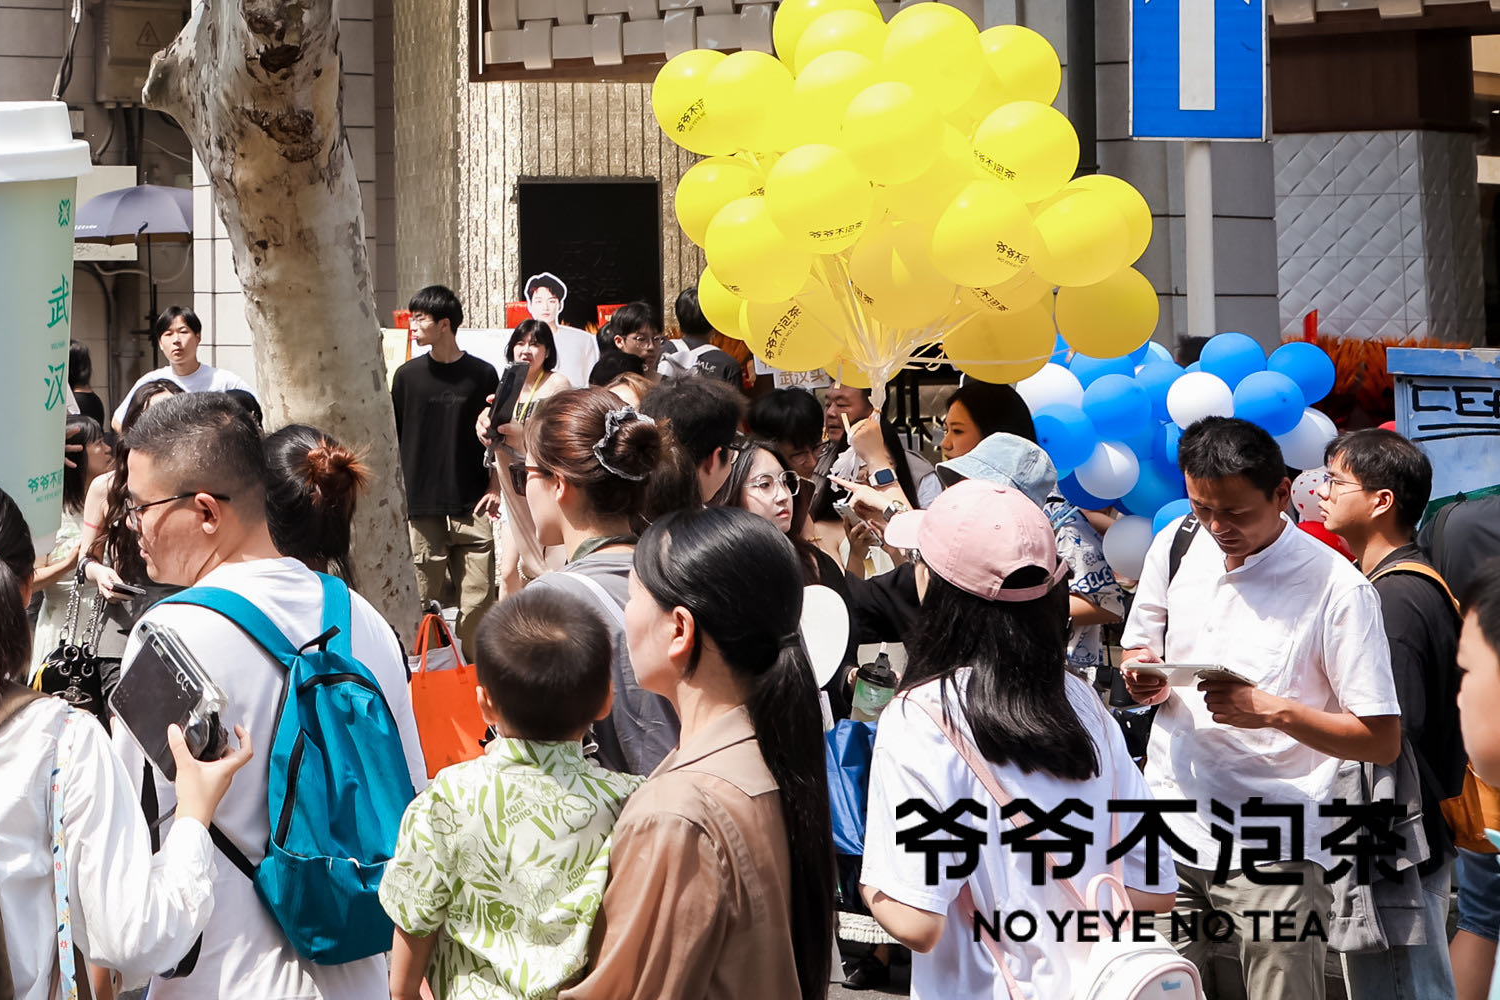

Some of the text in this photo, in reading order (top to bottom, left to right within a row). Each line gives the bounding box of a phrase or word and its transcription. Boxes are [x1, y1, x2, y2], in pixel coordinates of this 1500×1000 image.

[764, 304, 802, 360] 爷爷不泡茶
